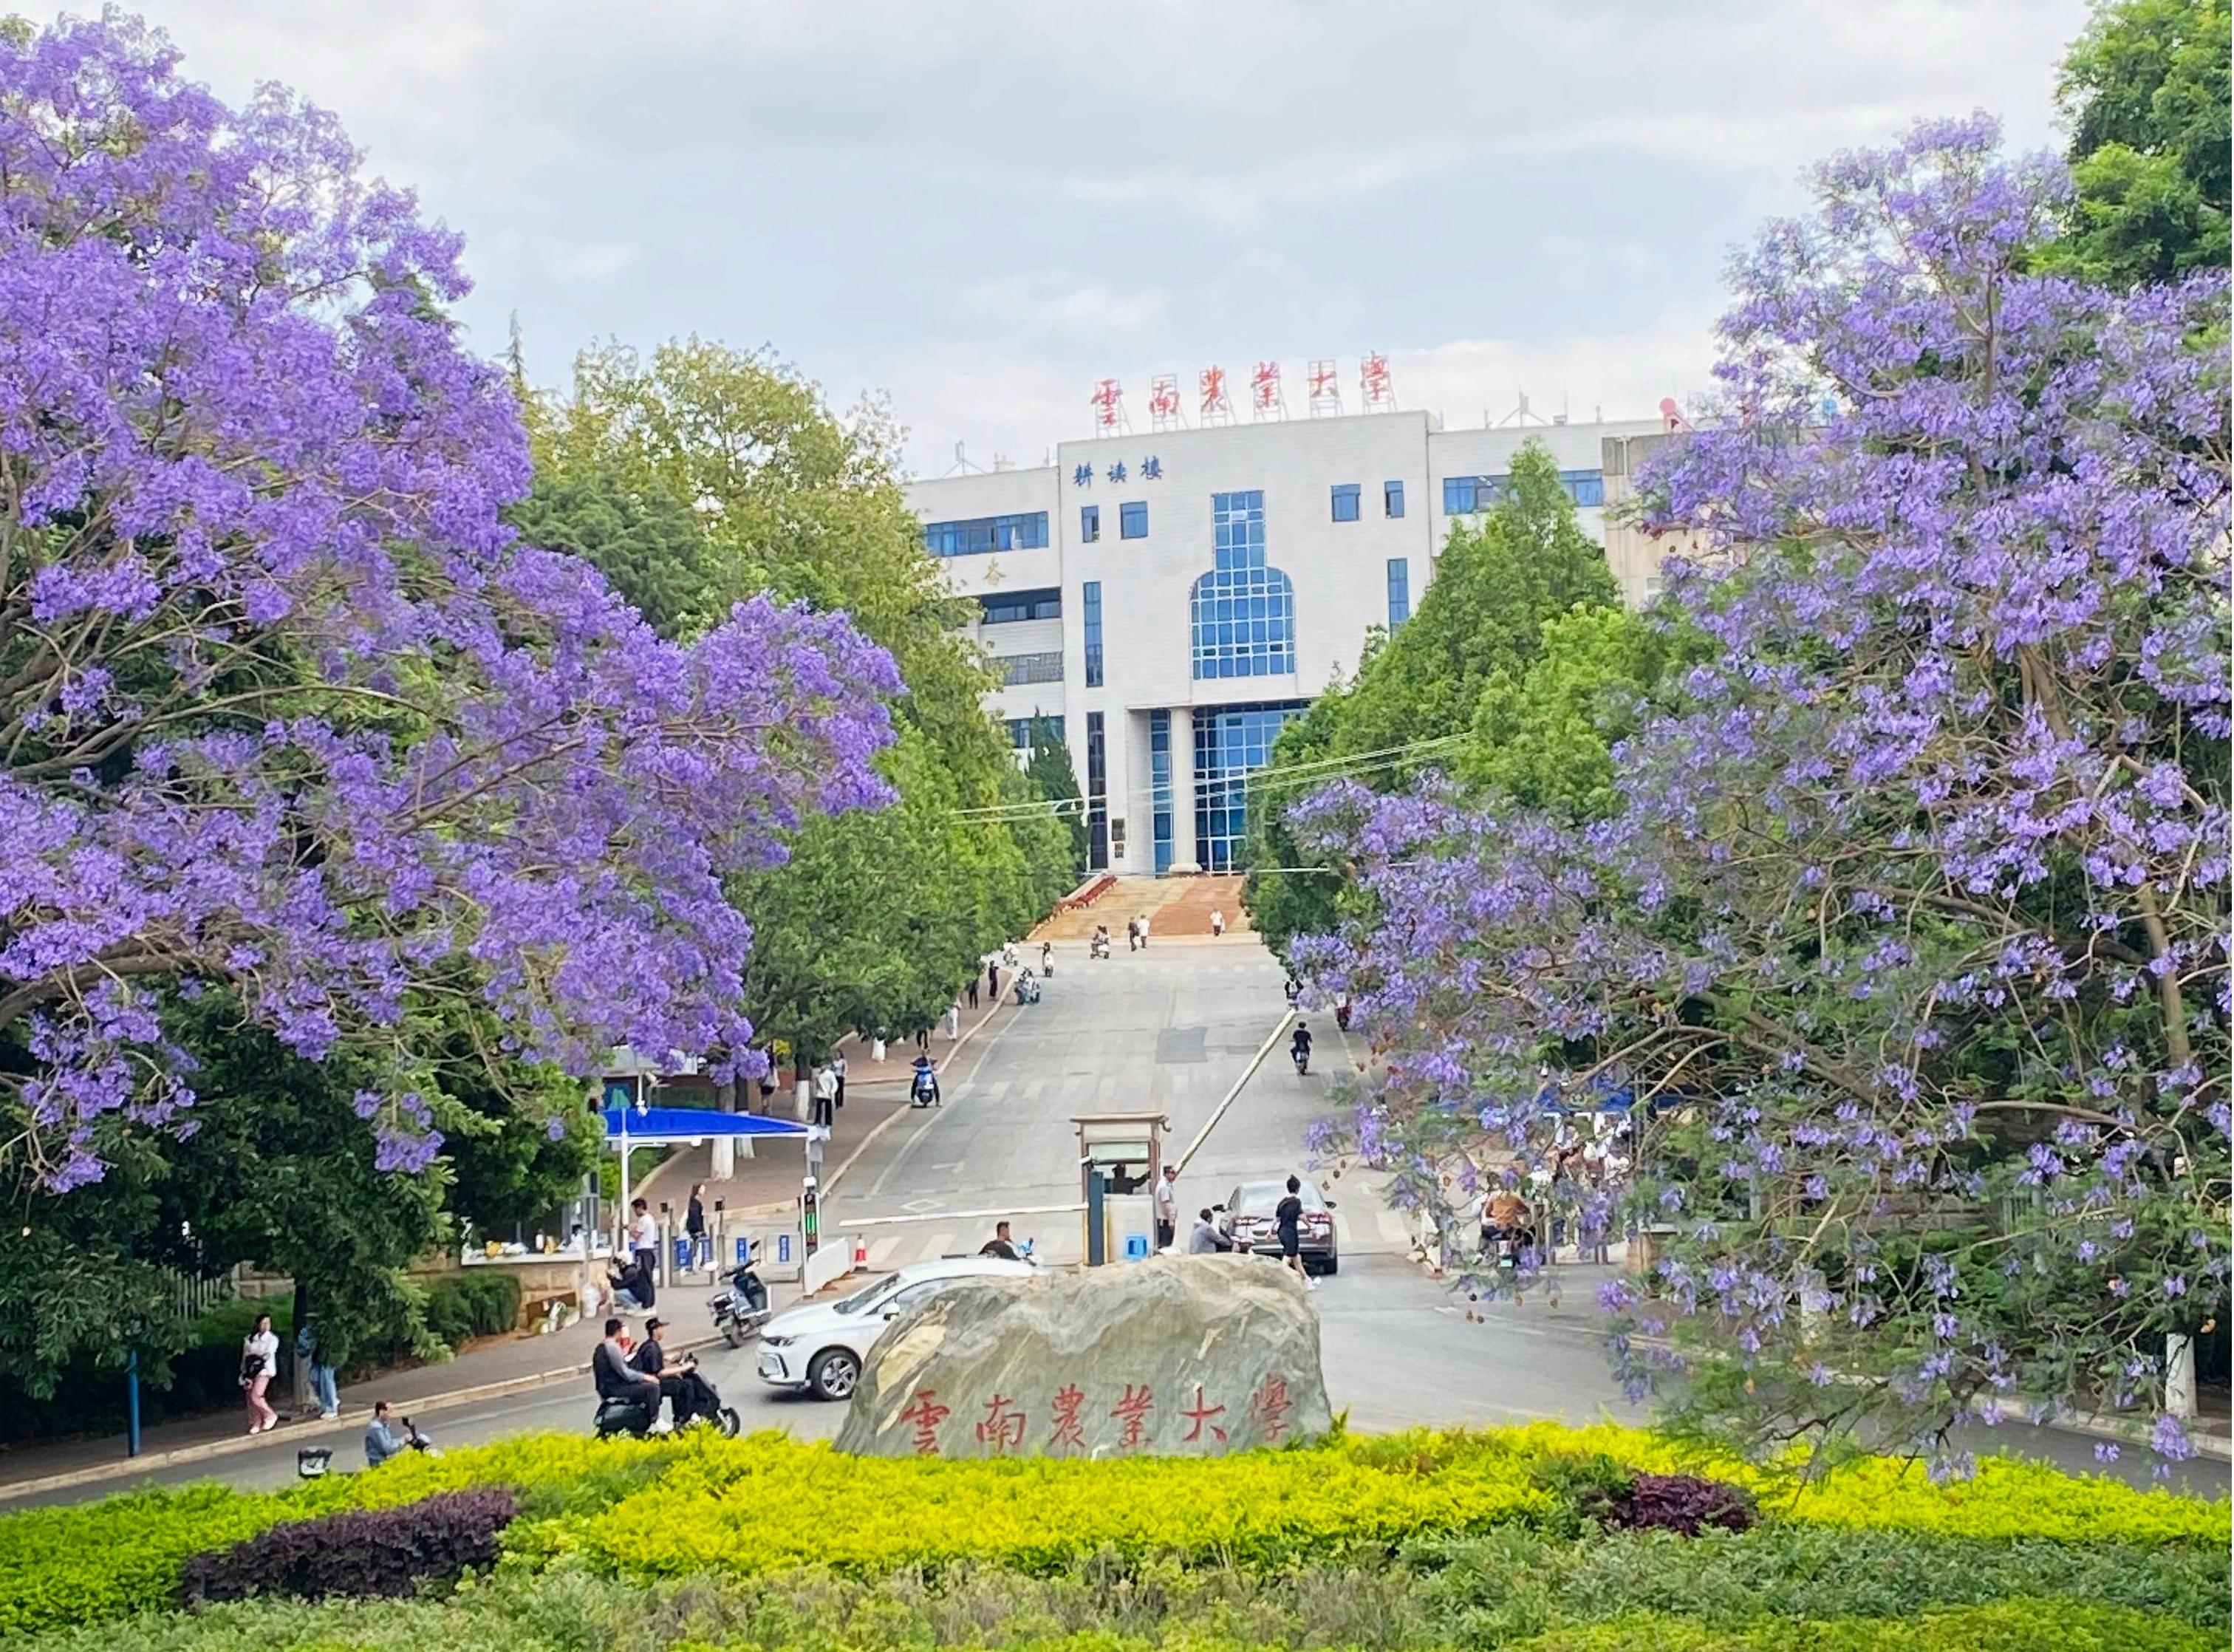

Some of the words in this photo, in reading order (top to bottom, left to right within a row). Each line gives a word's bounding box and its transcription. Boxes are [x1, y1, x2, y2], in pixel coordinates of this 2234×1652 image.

[900, 1372, 1294, 1454] 雲南農業大學
